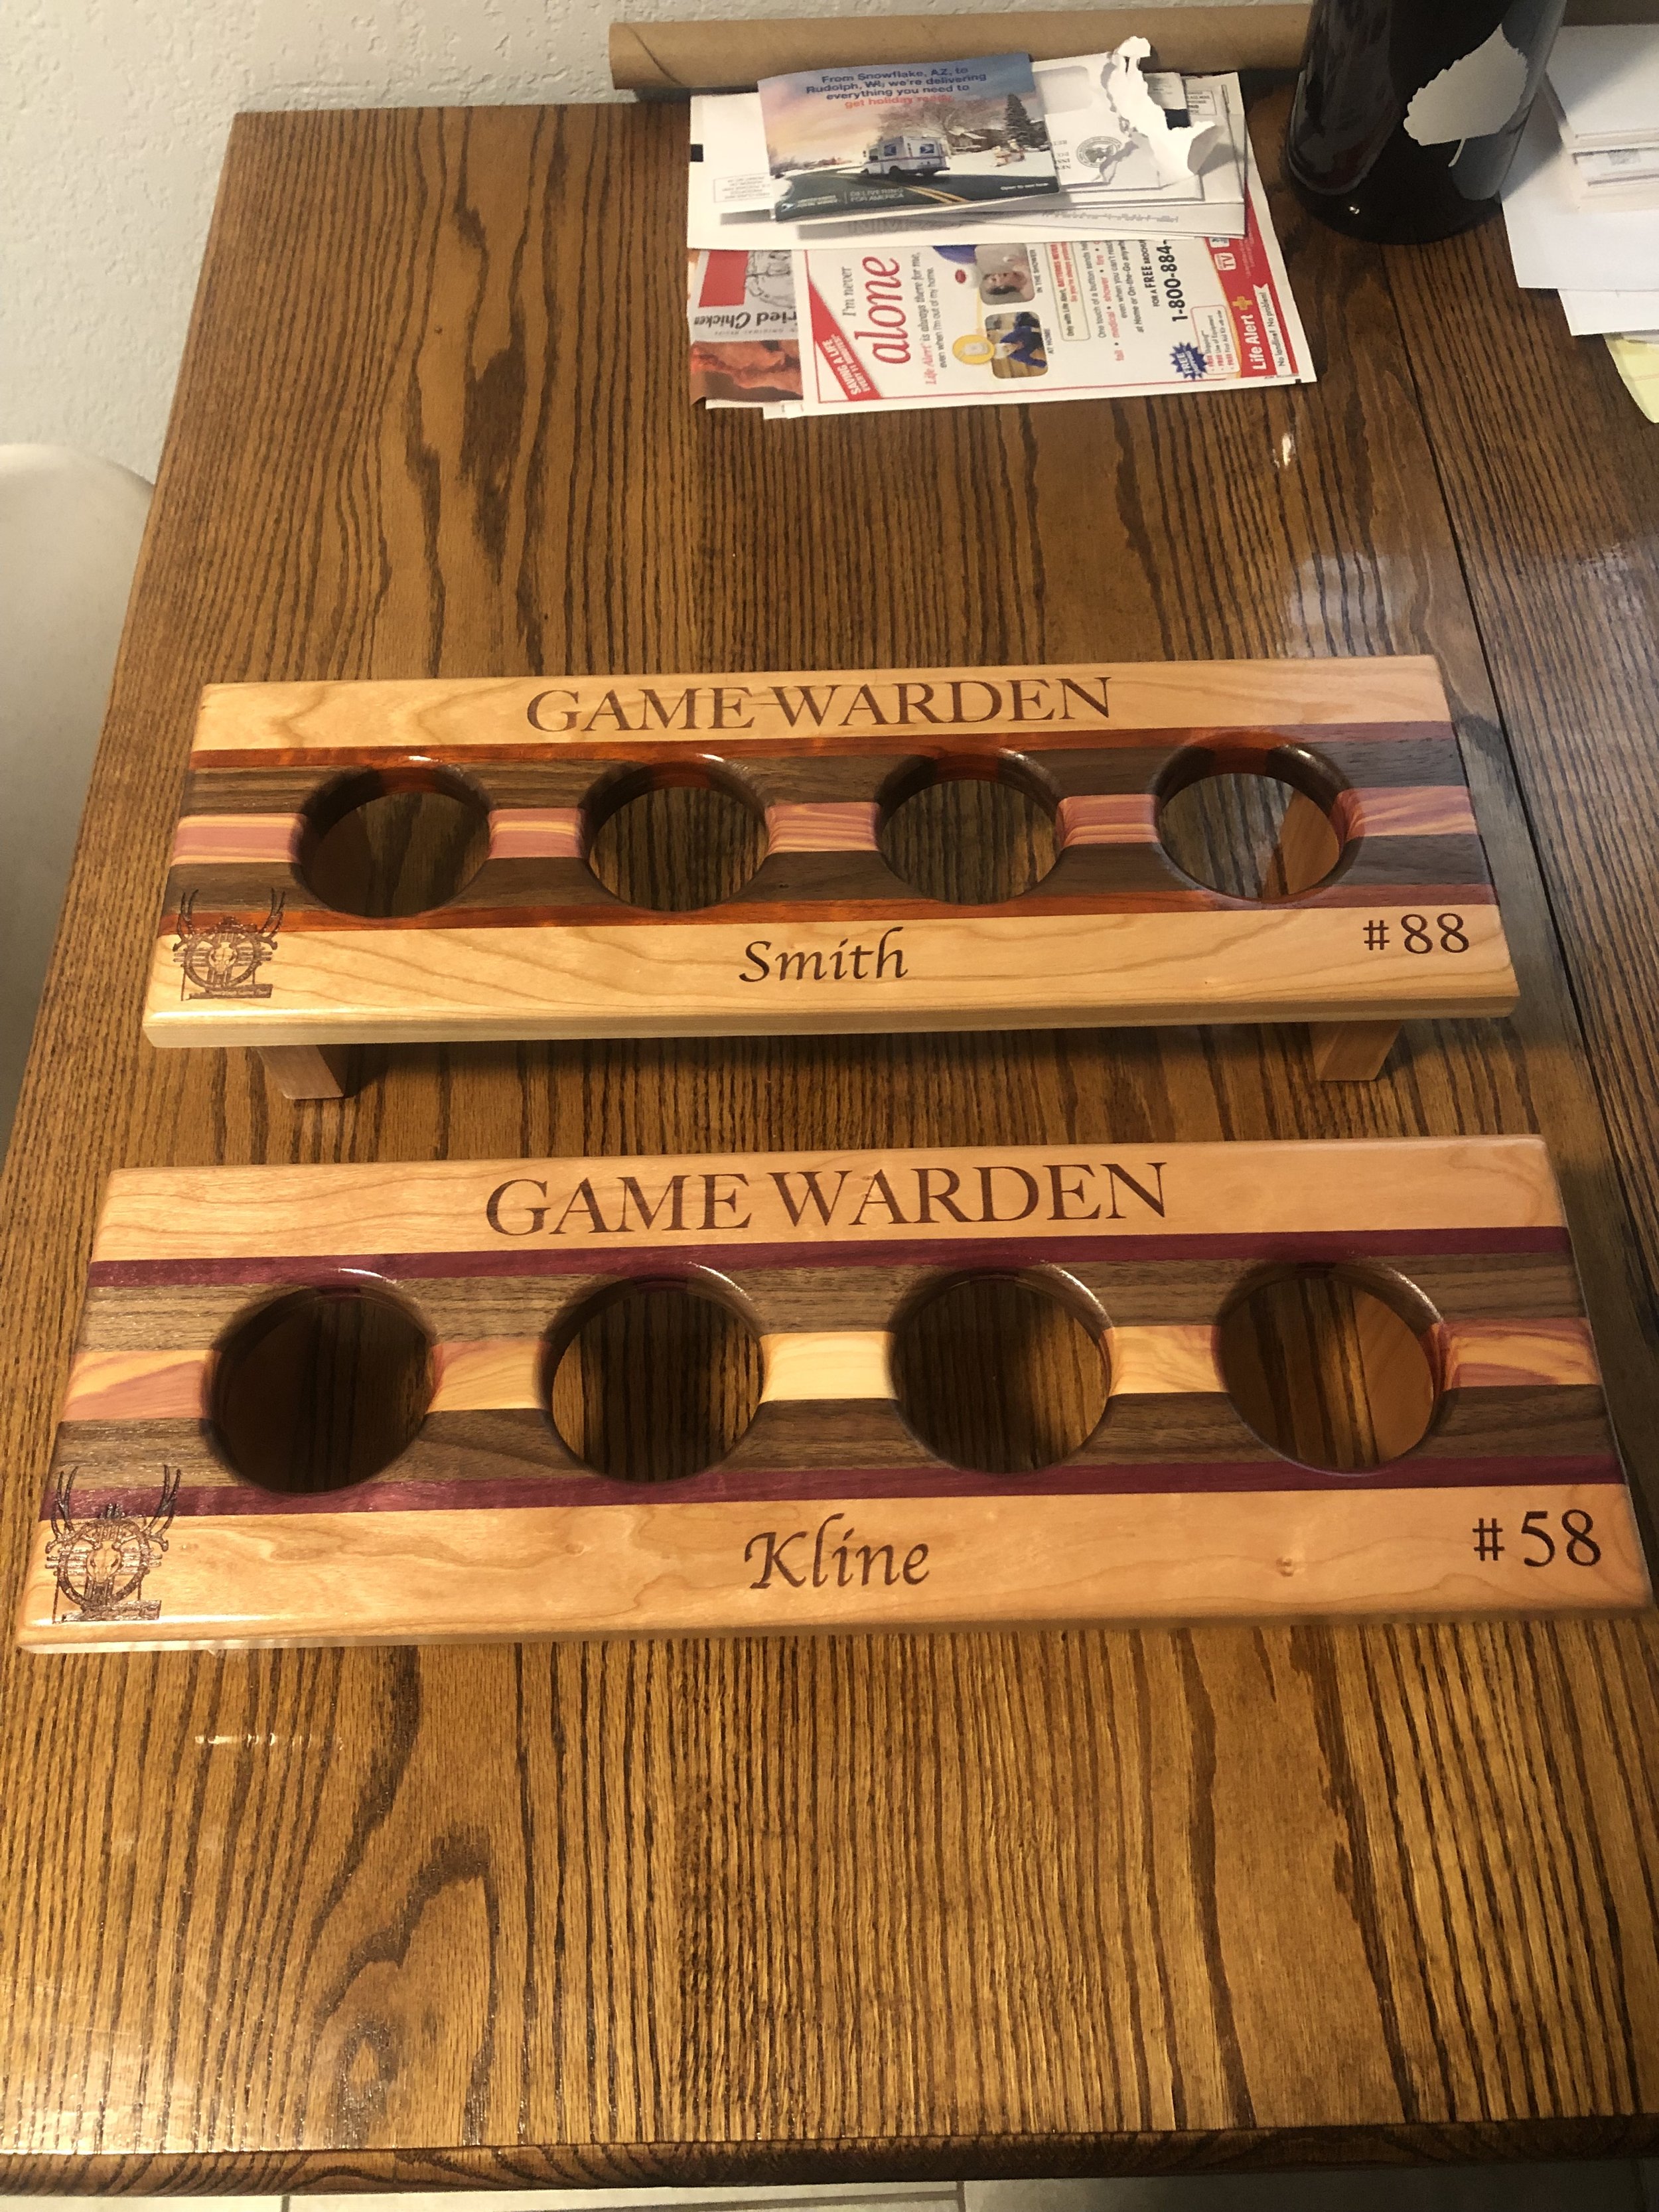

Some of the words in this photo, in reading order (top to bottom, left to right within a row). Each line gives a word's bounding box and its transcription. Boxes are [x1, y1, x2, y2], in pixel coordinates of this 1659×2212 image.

[806, 80, 862, 94] Rudolph,
[926, 73, 986, 85] delivering
[858, 70, 927, 80] Snowflake,
[826, 87, 893, 100] everything
[844, 99, 865, 110] get
[868, 95, 913, 105] holiday
[1050, 244, 1060, 259] NEVER
[1080, 242, 1089, 251] hel
[1029, 250, 1039, 273] SHOWER
[1083, 252, 1092, 269] sends
[1096, 255, 1104, 265] fire
[1108, 256, 1118, 271] can't
[1220, 255, 1235, 268] TV
[841, 267, 853, 295] never
[911, 269, 924, 280] for
[926, 267, 936, 287] home.
[1033, 274, 1042, 285] THE
[1054, 261, 1065, 287] BATTERIES
[1087, 271, 1097, 291] button
[1112, 272, 1122, 284] you
[1122, 262, 1135, 296] On-the-Go
[1141, 265, 1156, 288] FREE
[1157, 240, 1188, 323] 1-800-884-
[914, 283, 925, 303] there
[930, 289, 938, 299] my
[1100, 277, 1112, 302] shower
[842, 299, 856, 317] I'm
[1060, 303, 1070, 313] Life
[1151, 295, 1160, 307] FOR
[1259, 291, 1272, 316] problem!
[757, 311, 797, 326] ried
[854, 256, 910, 364] alone
[916, 305, 930, 331] always
[932, 307, 941, 319] out
[1094, 307, 1104, 324] touch
[1118, 304, 1128, 319] even
[1130, 306, 1142, 325] Home
[694, 312, 751, 329] Chicken
[932, 320, 942, 330] I'm
[1106, 311, 1119, 338] medical
[1207, 315, 1218, 338] Equipment
[1241, 314, 1260, 344] Alert
[1267, 319, 1275, 327] No
[1098, 325, 1107, 338] One
[822, 338, 840, 356] LIFE
[934, 331, 945, 350] when
[1222, 344, 1231, 352] First
[937, 352, 947, 368] even
[1114, 350, 1124, 361] fall
[1177, 352, 1192, 374] FREE
[1215, 354, 1224, 366] FREE
[1225, 354, 1234, 366] FREE
[1250, 346, 1267, 370] Life
[1275, 357, 1285, 366] No
[837, 364, 861, 395] SAVING
[924, 368, 938, 385] Life
[527, 689, 755, 732] GAME
[768, 676, 1112, 727] WARDEN
[1362, 913, 1469, 954] #88
[739, 926, 908, 982] Smith
[486, 1173, 752, 1236] GAME
[766, 1162, 1167, 1226] WARDEN
[1472, 1509, 1601, 1567] #58
[744, 1512, 930, 1589] Kline
